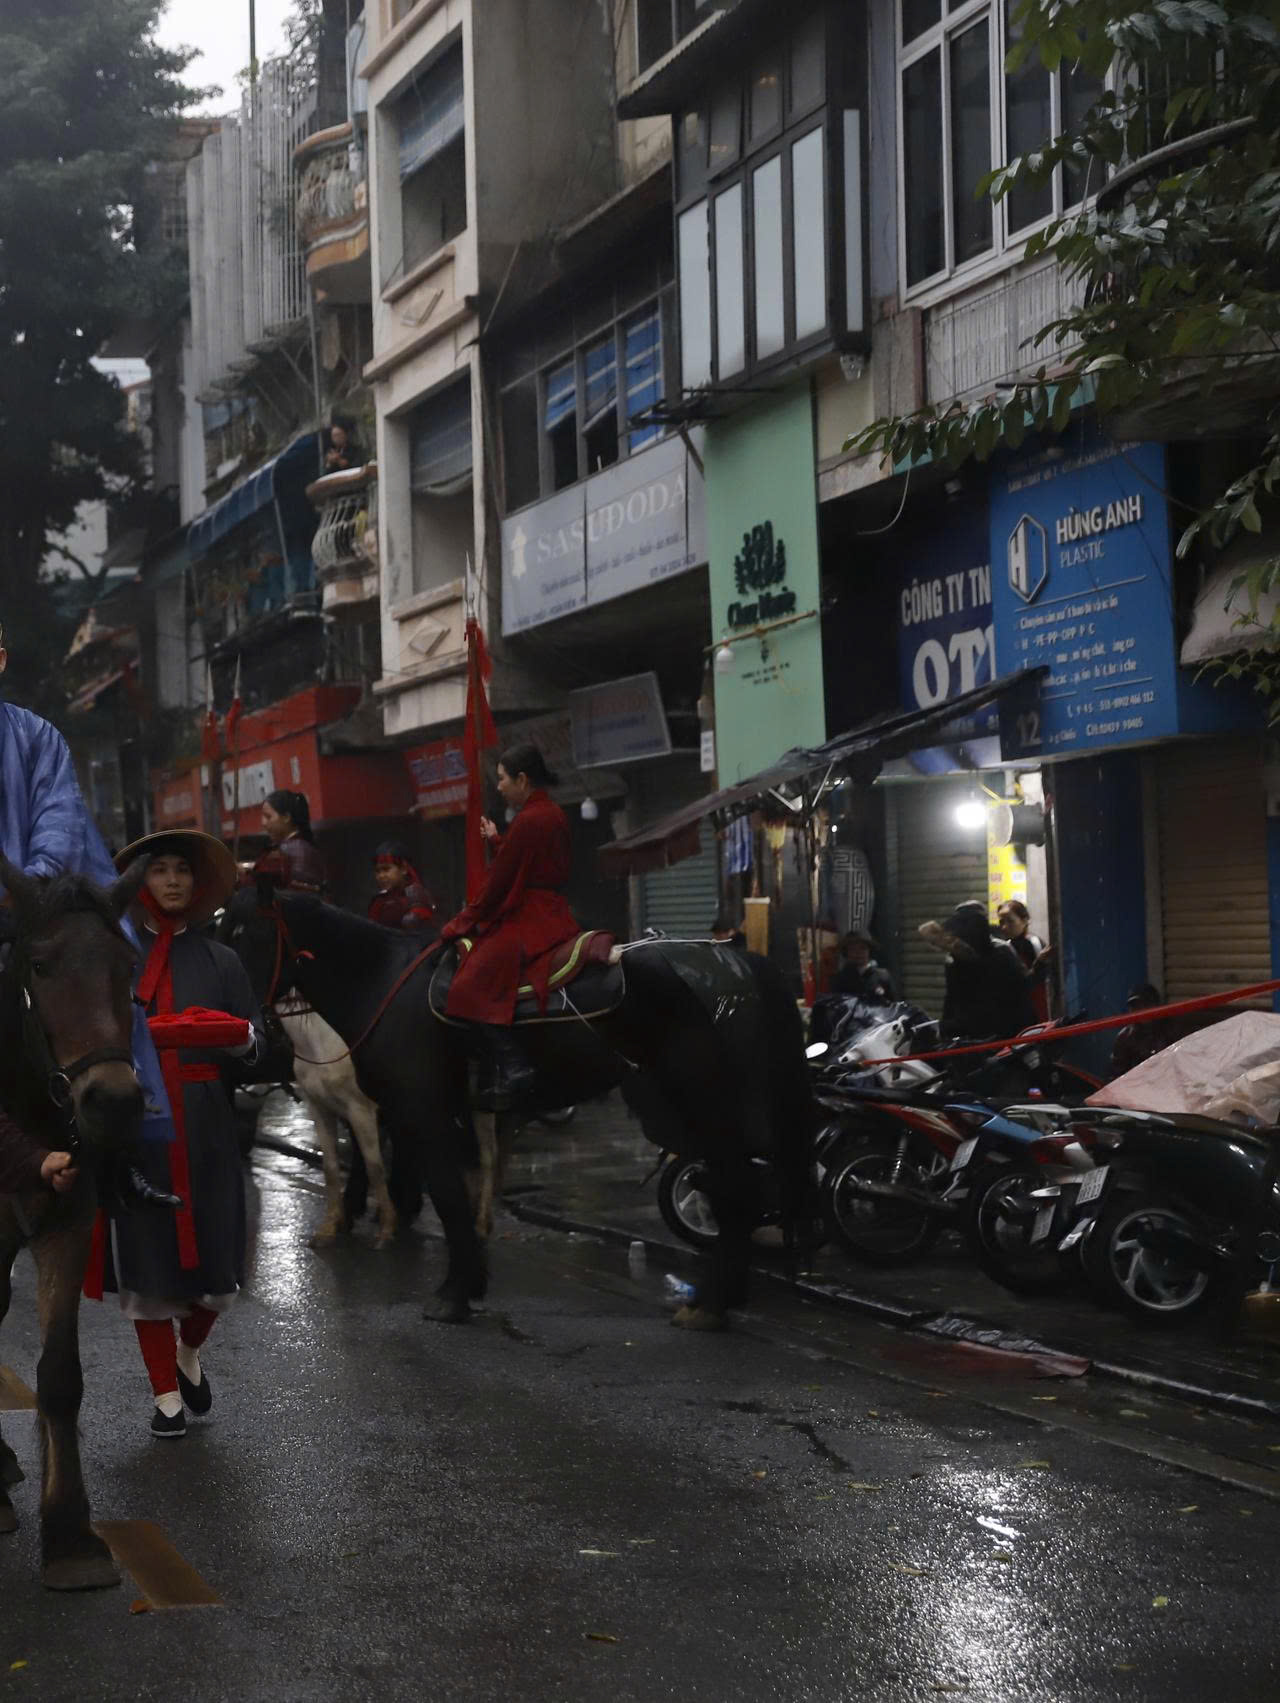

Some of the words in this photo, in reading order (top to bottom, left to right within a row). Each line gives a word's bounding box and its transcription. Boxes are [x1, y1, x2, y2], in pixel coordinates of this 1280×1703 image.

[1056, 506, 1103, 545] HÙNG
[1105, 493, 1141, 530] ANH
[1060, 538, 1105, 569] PLASTIC
[901, 577, 944, 627] CÔNG
[945, 571, 965, 614] TY
[968, 565, 992, 609] TN
